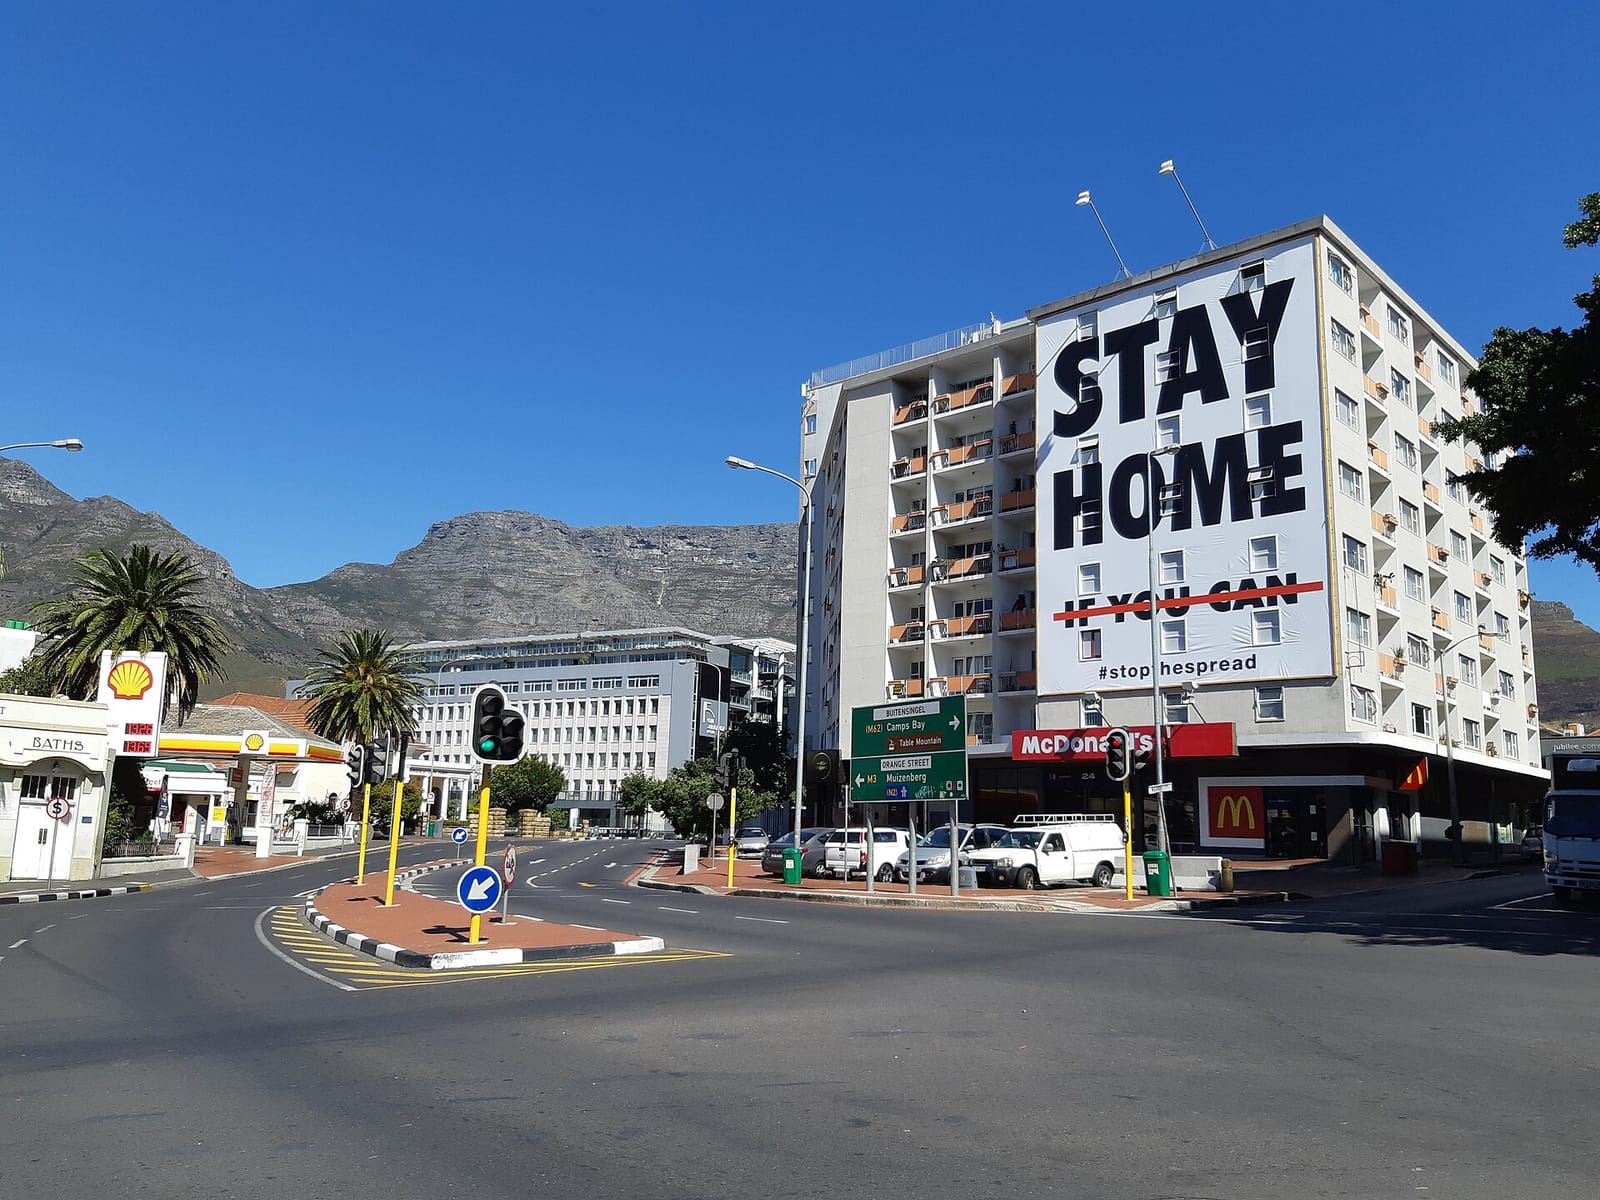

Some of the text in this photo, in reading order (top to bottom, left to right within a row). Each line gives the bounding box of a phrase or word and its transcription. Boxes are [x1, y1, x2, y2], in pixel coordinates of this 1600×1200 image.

[1053, 277, 1296, 438] STAY
[1053, 420, 1307, 550] HOME
[1064, 573, 1298, 628] IF YOU CAN
[1099, 654, 1257, 680] #stophespread
[886, 707, 926, 717] BUITENSINGEL
[865, 719, 926, 734] (M62) Camps Bay
[32, 736, 84, 751] BATHS
[899, 736, 942, 748] Table Mountain
[1553, 743, 1579, 753] jubilee
[882, 758, 930, 769] ORANGE STREET
[866, 772, 927, 784] M3 Muizenberg
[1080, 772, 1096, 780] 24
